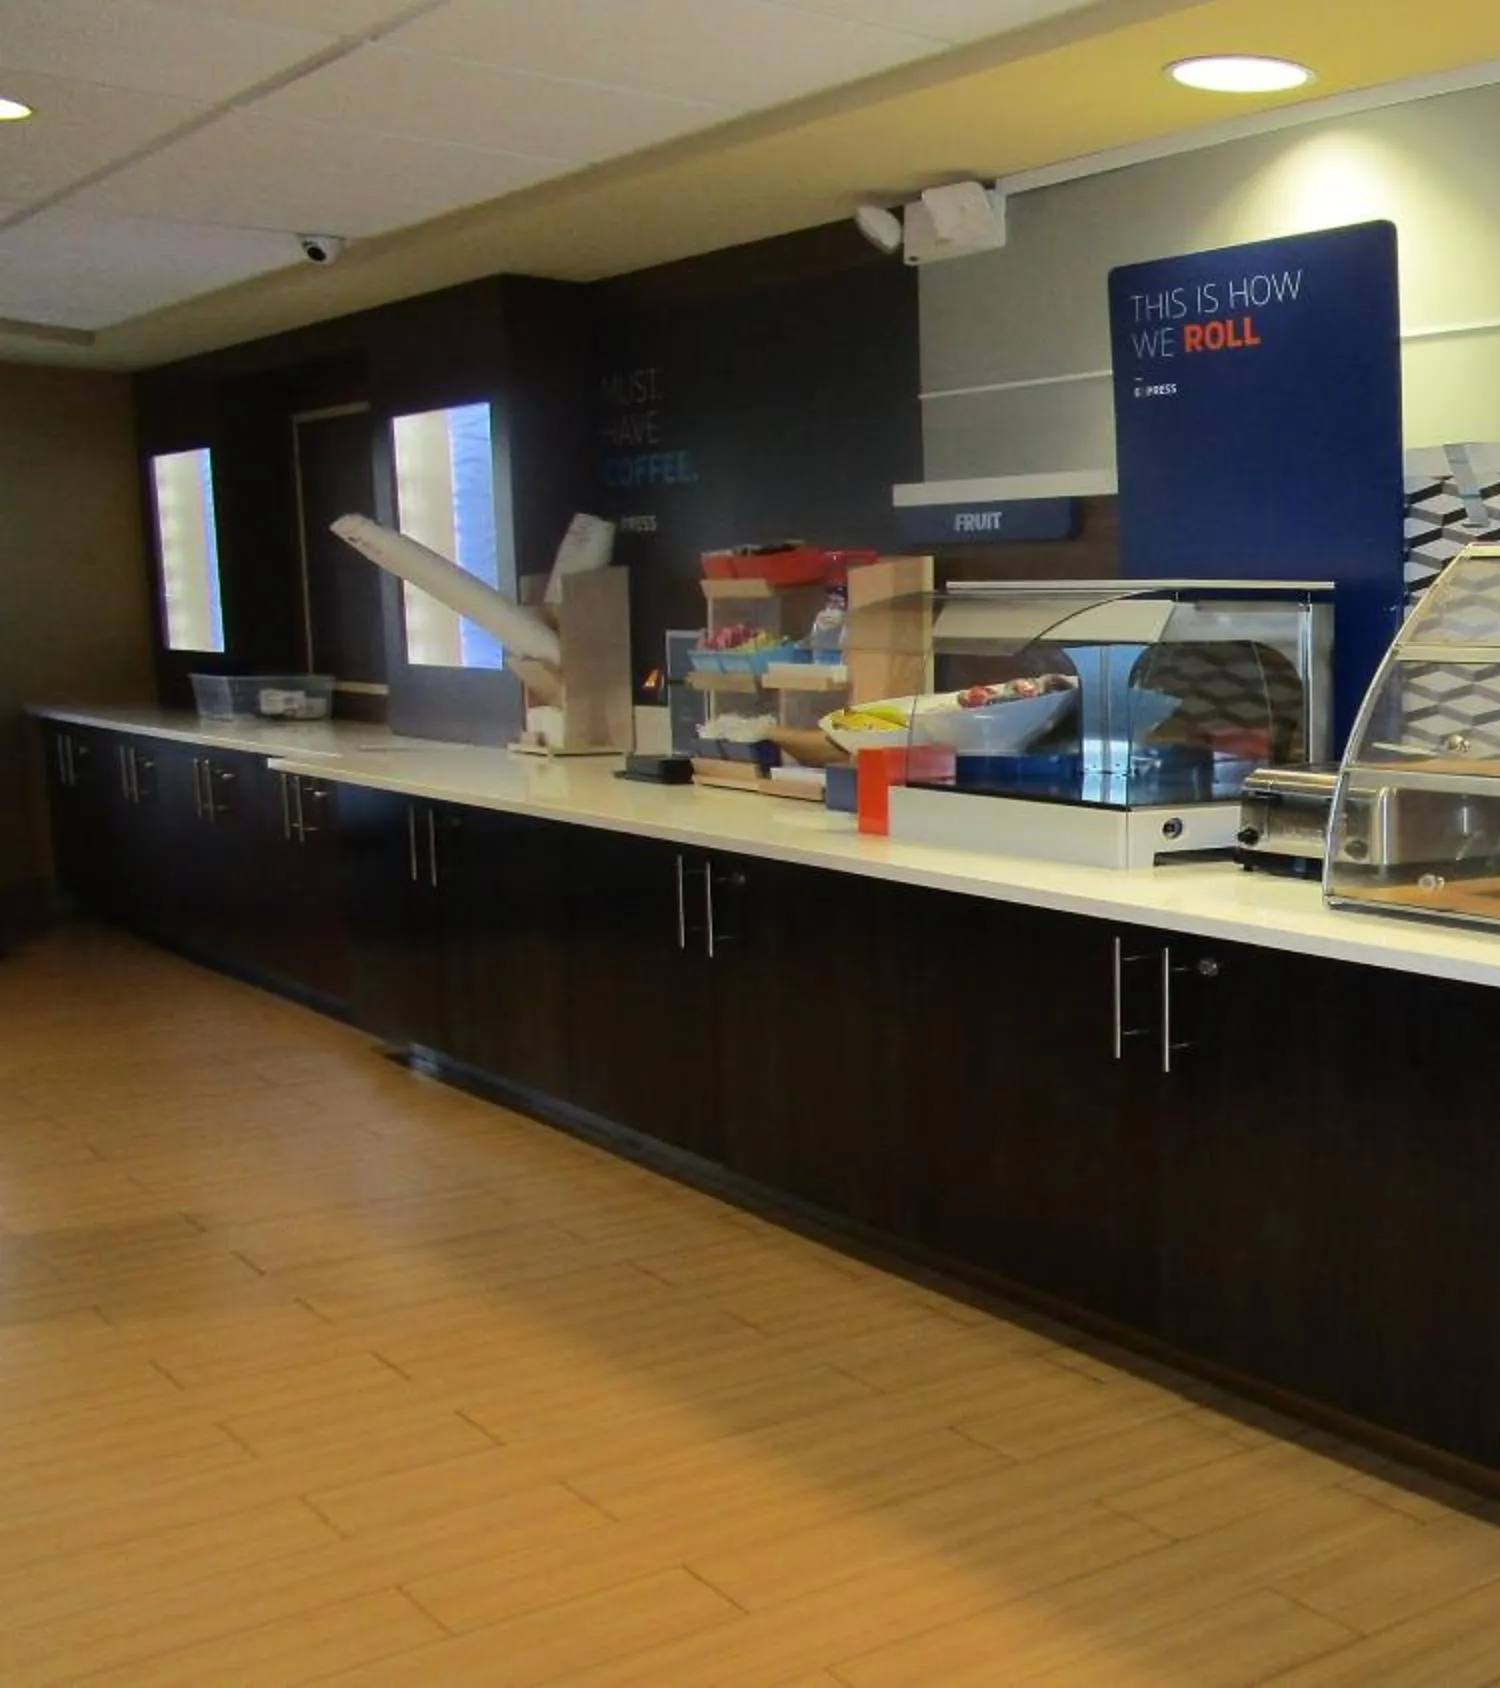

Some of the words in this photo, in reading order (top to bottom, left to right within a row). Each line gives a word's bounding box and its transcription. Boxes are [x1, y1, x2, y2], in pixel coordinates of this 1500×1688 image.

[1130, 288, 1188, 322] THIS
[1197, 283, 1219, 314] IS
[1228, 269, 1303, 308] HOW
[1131, 327, 1174, 358] WE
[1183, 316, 1261, 353] ROLL
[1133, 383, 1177, 398] EPRESS
[954, 511, 1003, 532] FRUIT
